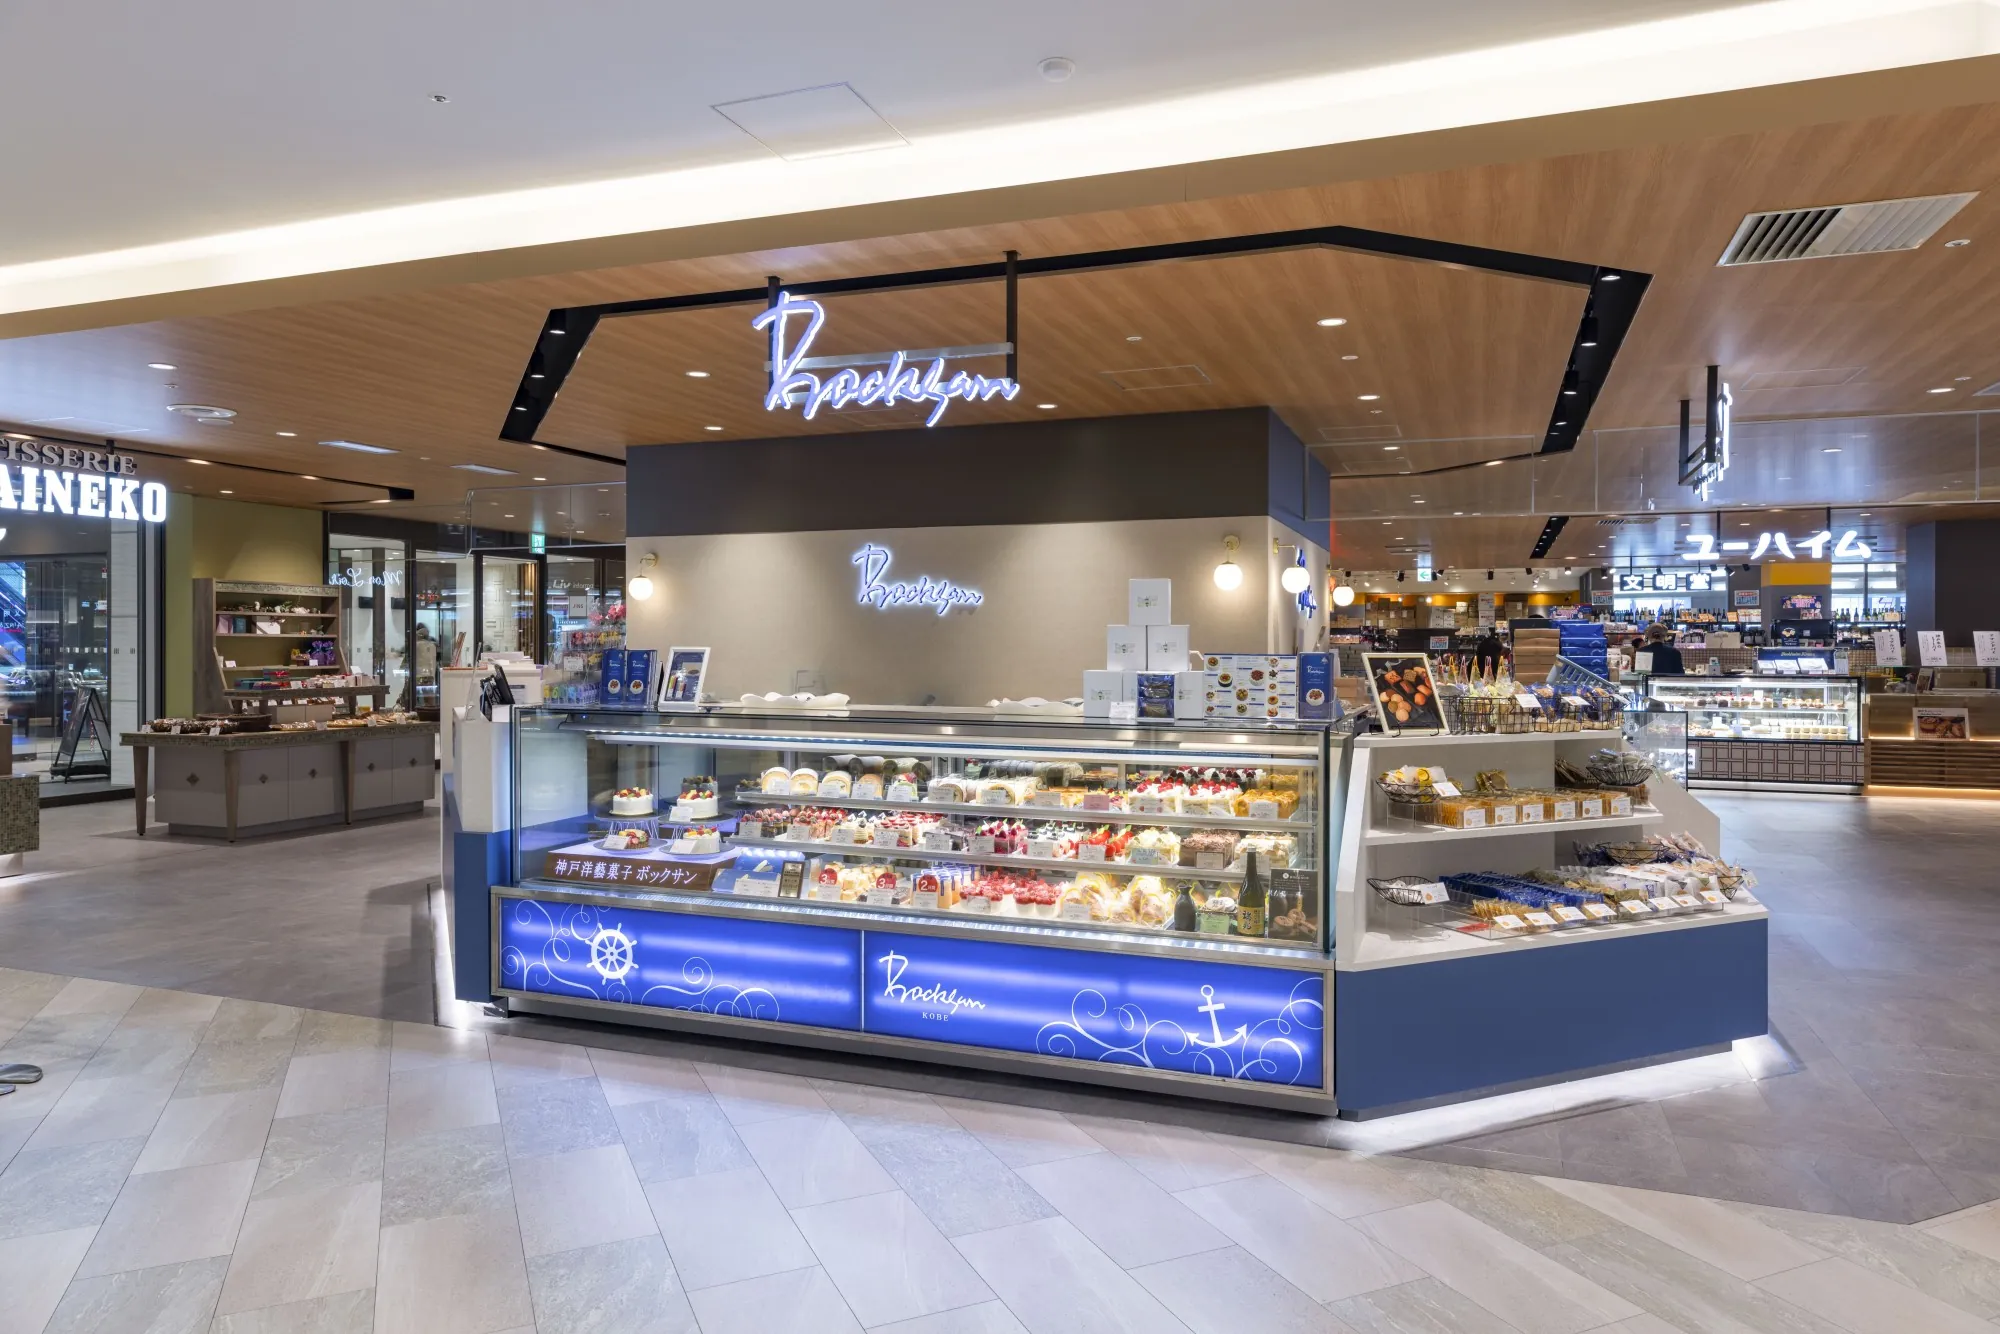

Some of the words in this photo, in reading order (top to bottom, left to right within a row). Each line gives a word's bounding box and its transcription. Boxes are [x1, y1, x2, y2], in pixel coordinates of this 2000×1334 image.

[1681, 530, 1872, 561] ユーハイム
[1623, 573, 1711, 591] 文明堂
[554, 858, 633, 881] 神戸洋藝菓子
[636, 865, 698, 885] ボックサン
[922, 1011, 949, 1022] KOBE
